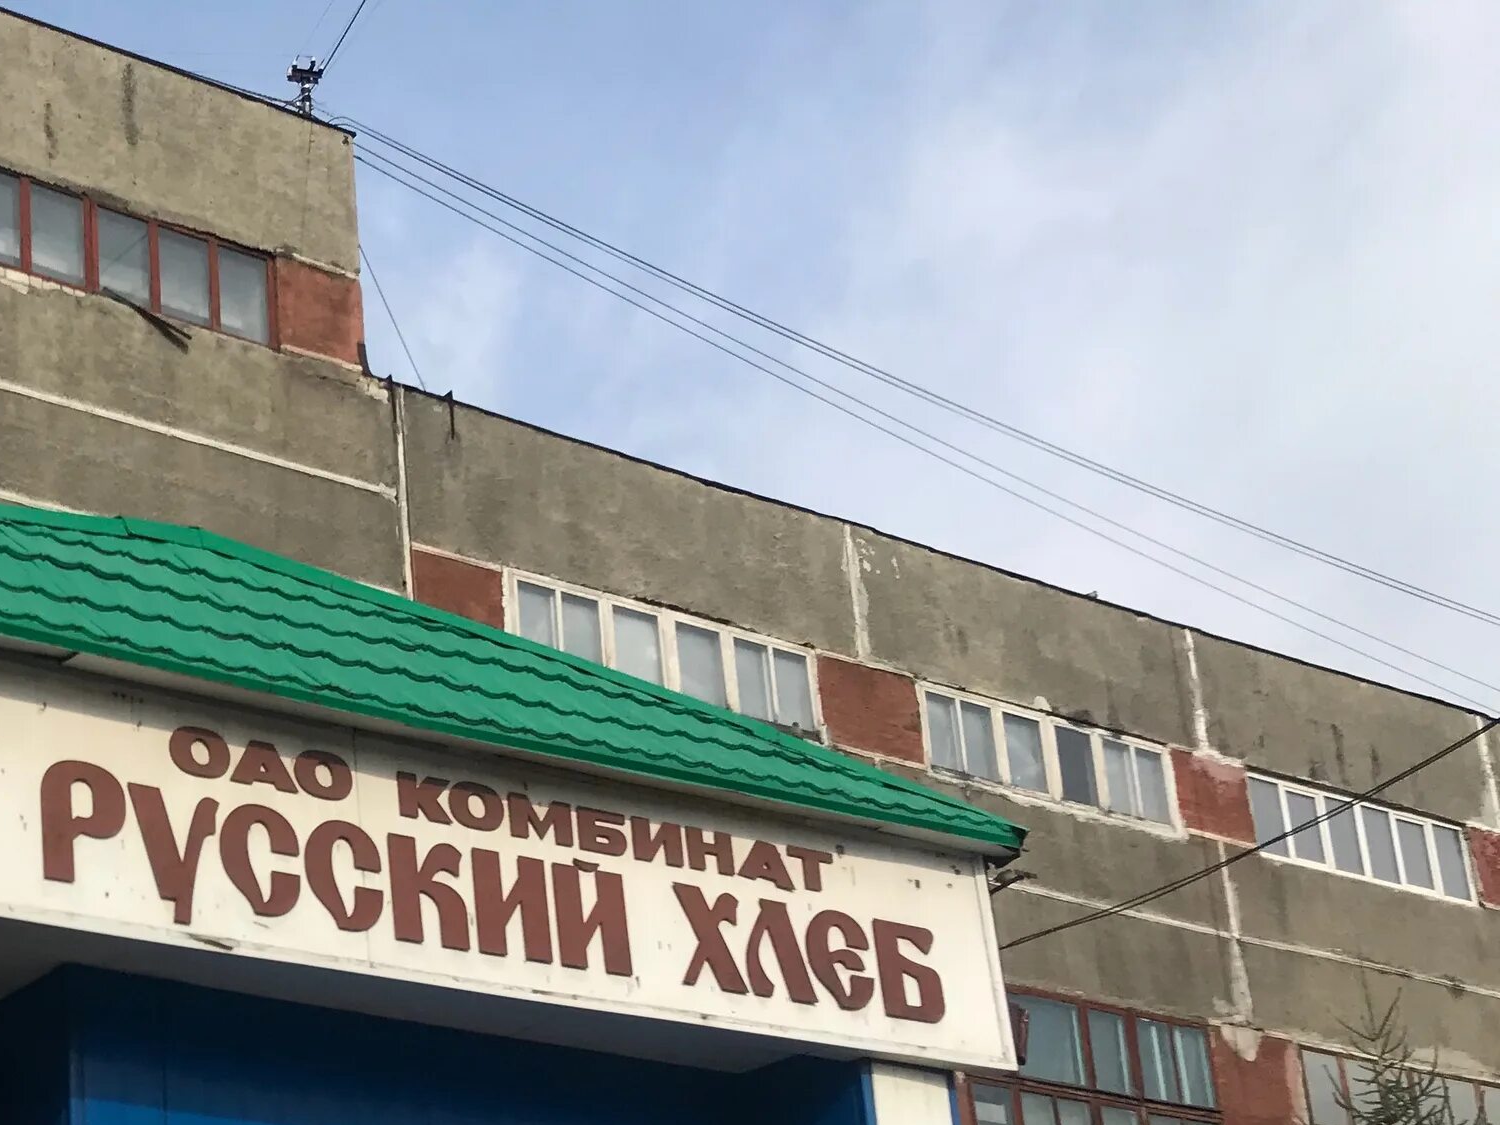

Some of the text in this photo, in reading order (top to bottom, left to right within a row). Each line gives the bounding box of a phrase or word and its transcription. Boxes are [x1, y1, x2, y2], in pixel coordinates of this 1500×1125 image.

[40, 759, 633, 978] РУССКИЙ
[169, 725, 836, 892] ОАО КОМБИНАТ
